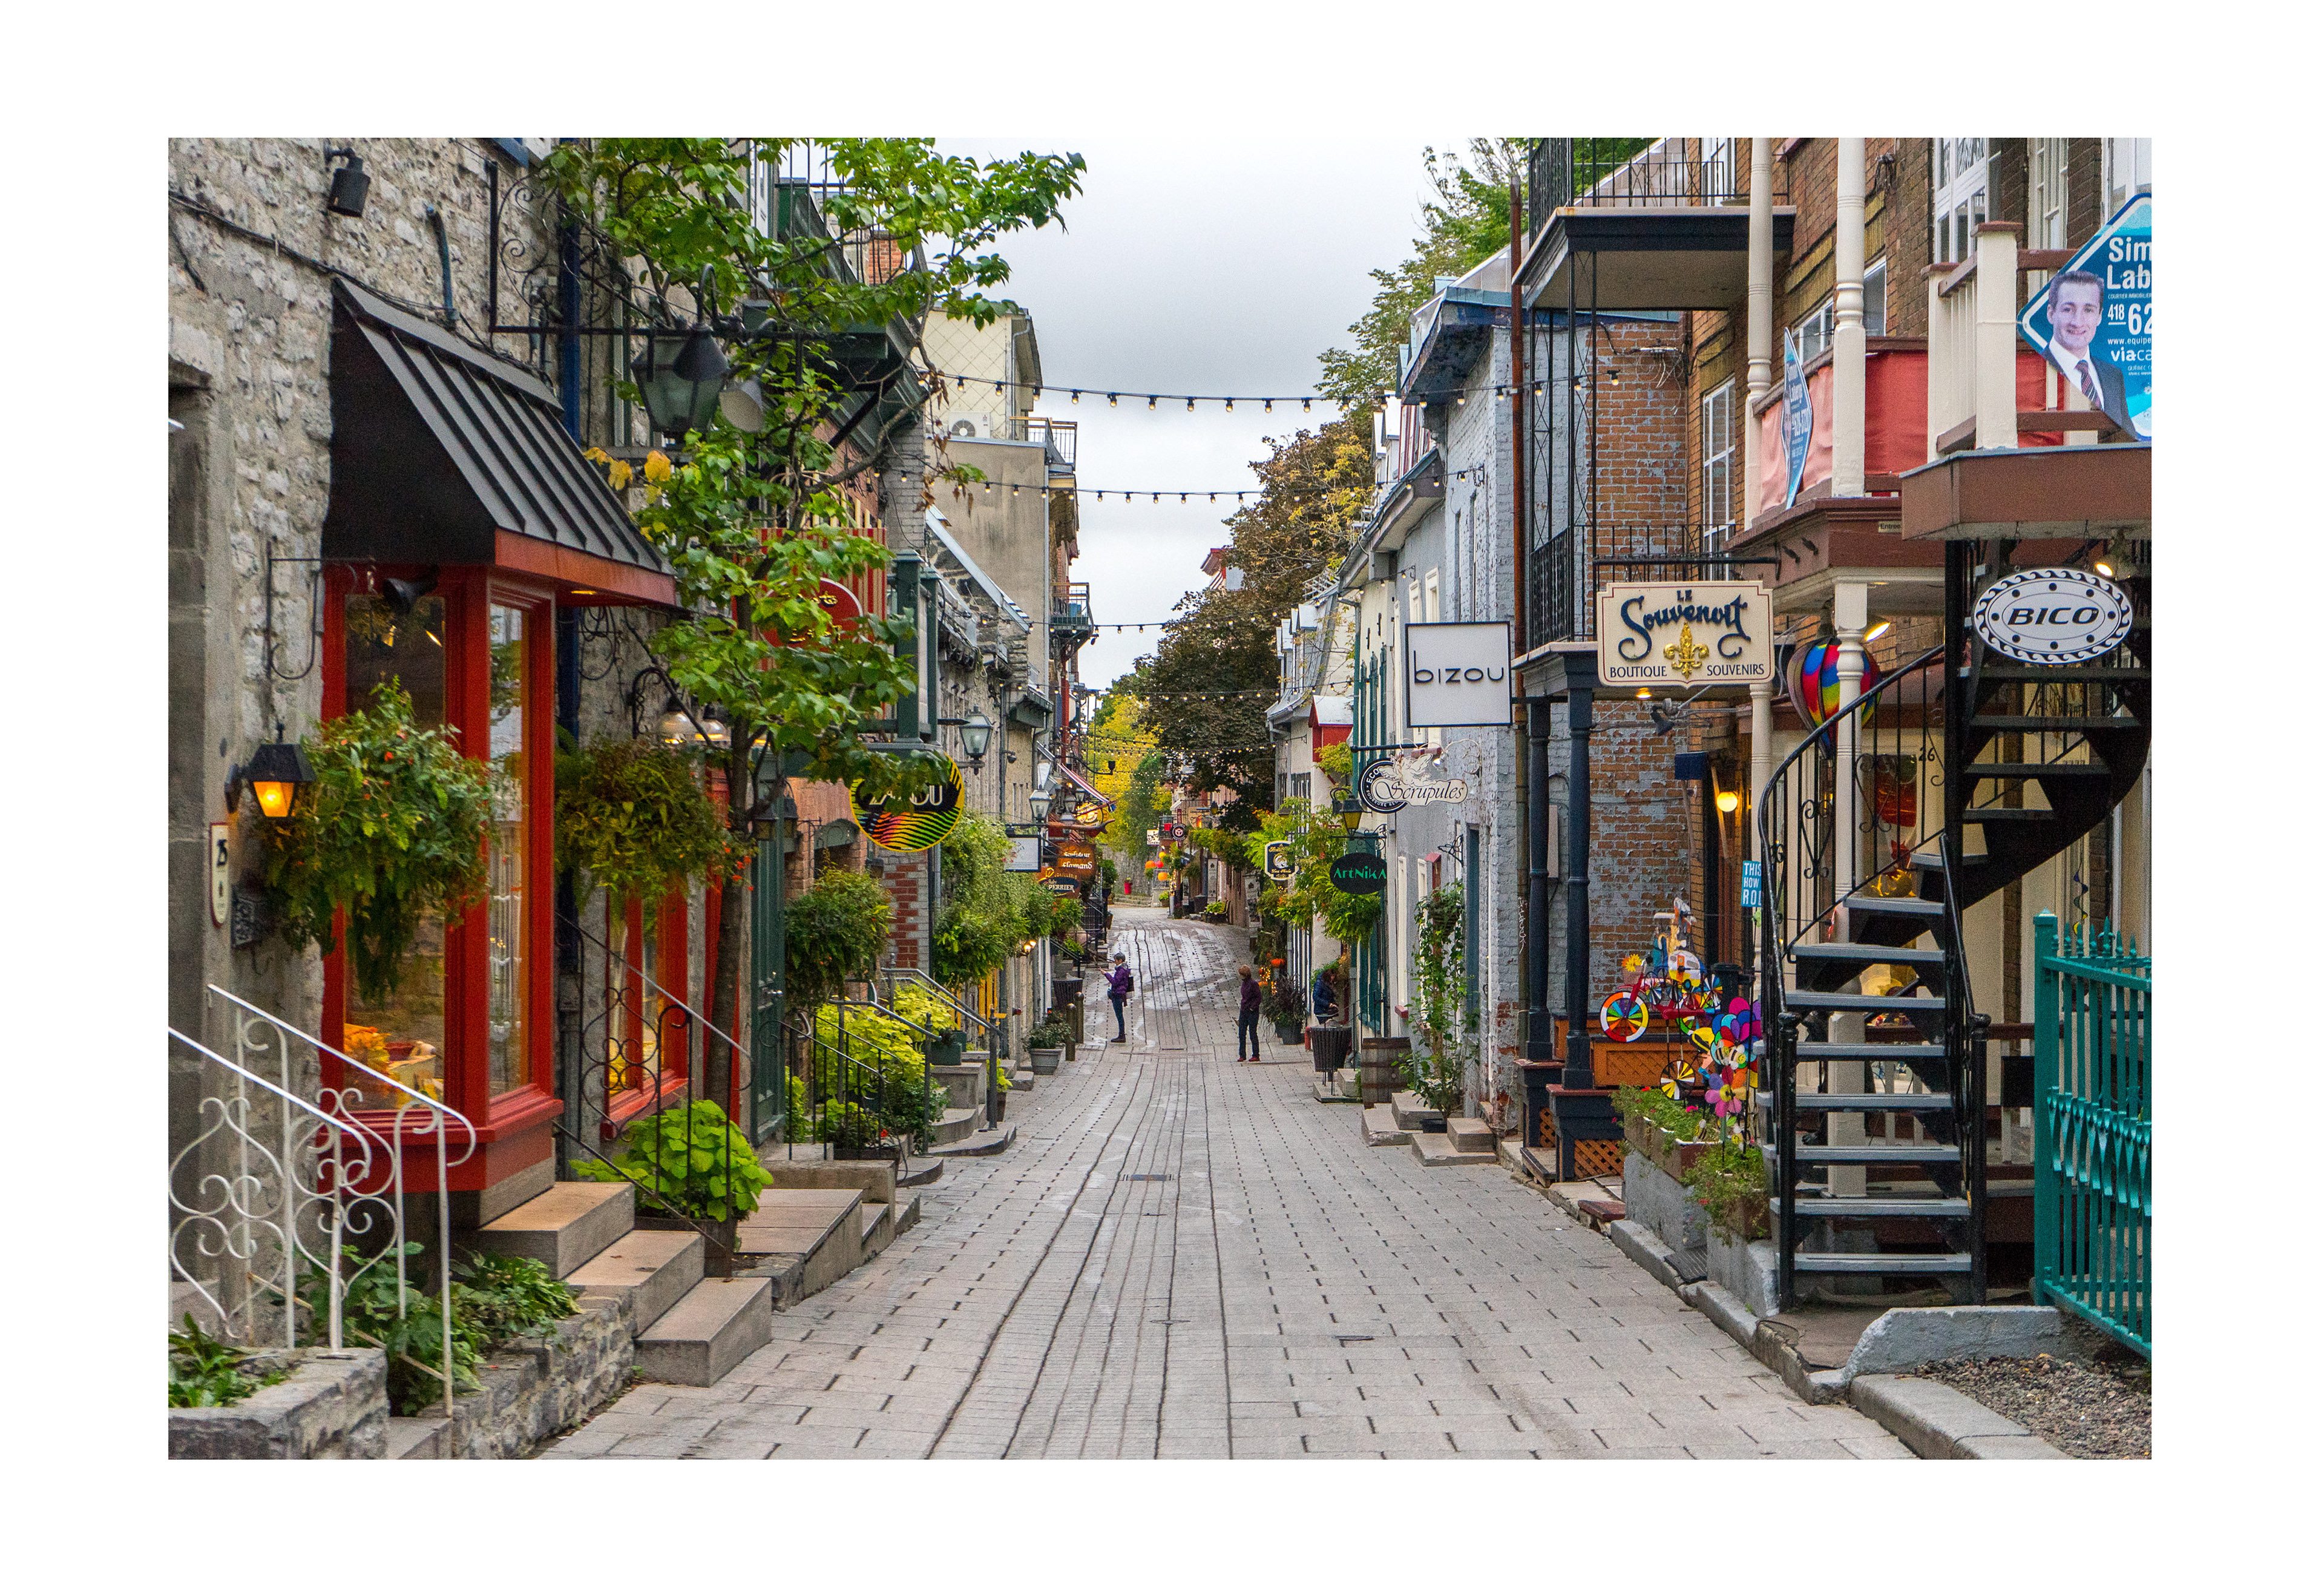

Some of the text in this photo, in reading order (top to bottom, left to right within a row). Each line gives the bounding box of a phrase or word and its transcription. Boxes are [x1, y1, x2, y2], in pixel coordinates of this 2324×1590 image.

[2107, 264, 2151, 289] Lab
[2107, 304, 2124, 320] 418
[1676, 590, 1692, 601] LE
[2007, 607, 2099, 625] BICO
[1414, 650, 1504, 684] bizou
[1610, 664, 1764, 678] BOUTIQUE SOUVENIRS
[1375, 781, 1464, 805] Scrupules
[1048, 884, 1075, 893] PERRIER
[1744, 877, 1759, 889] HOW
